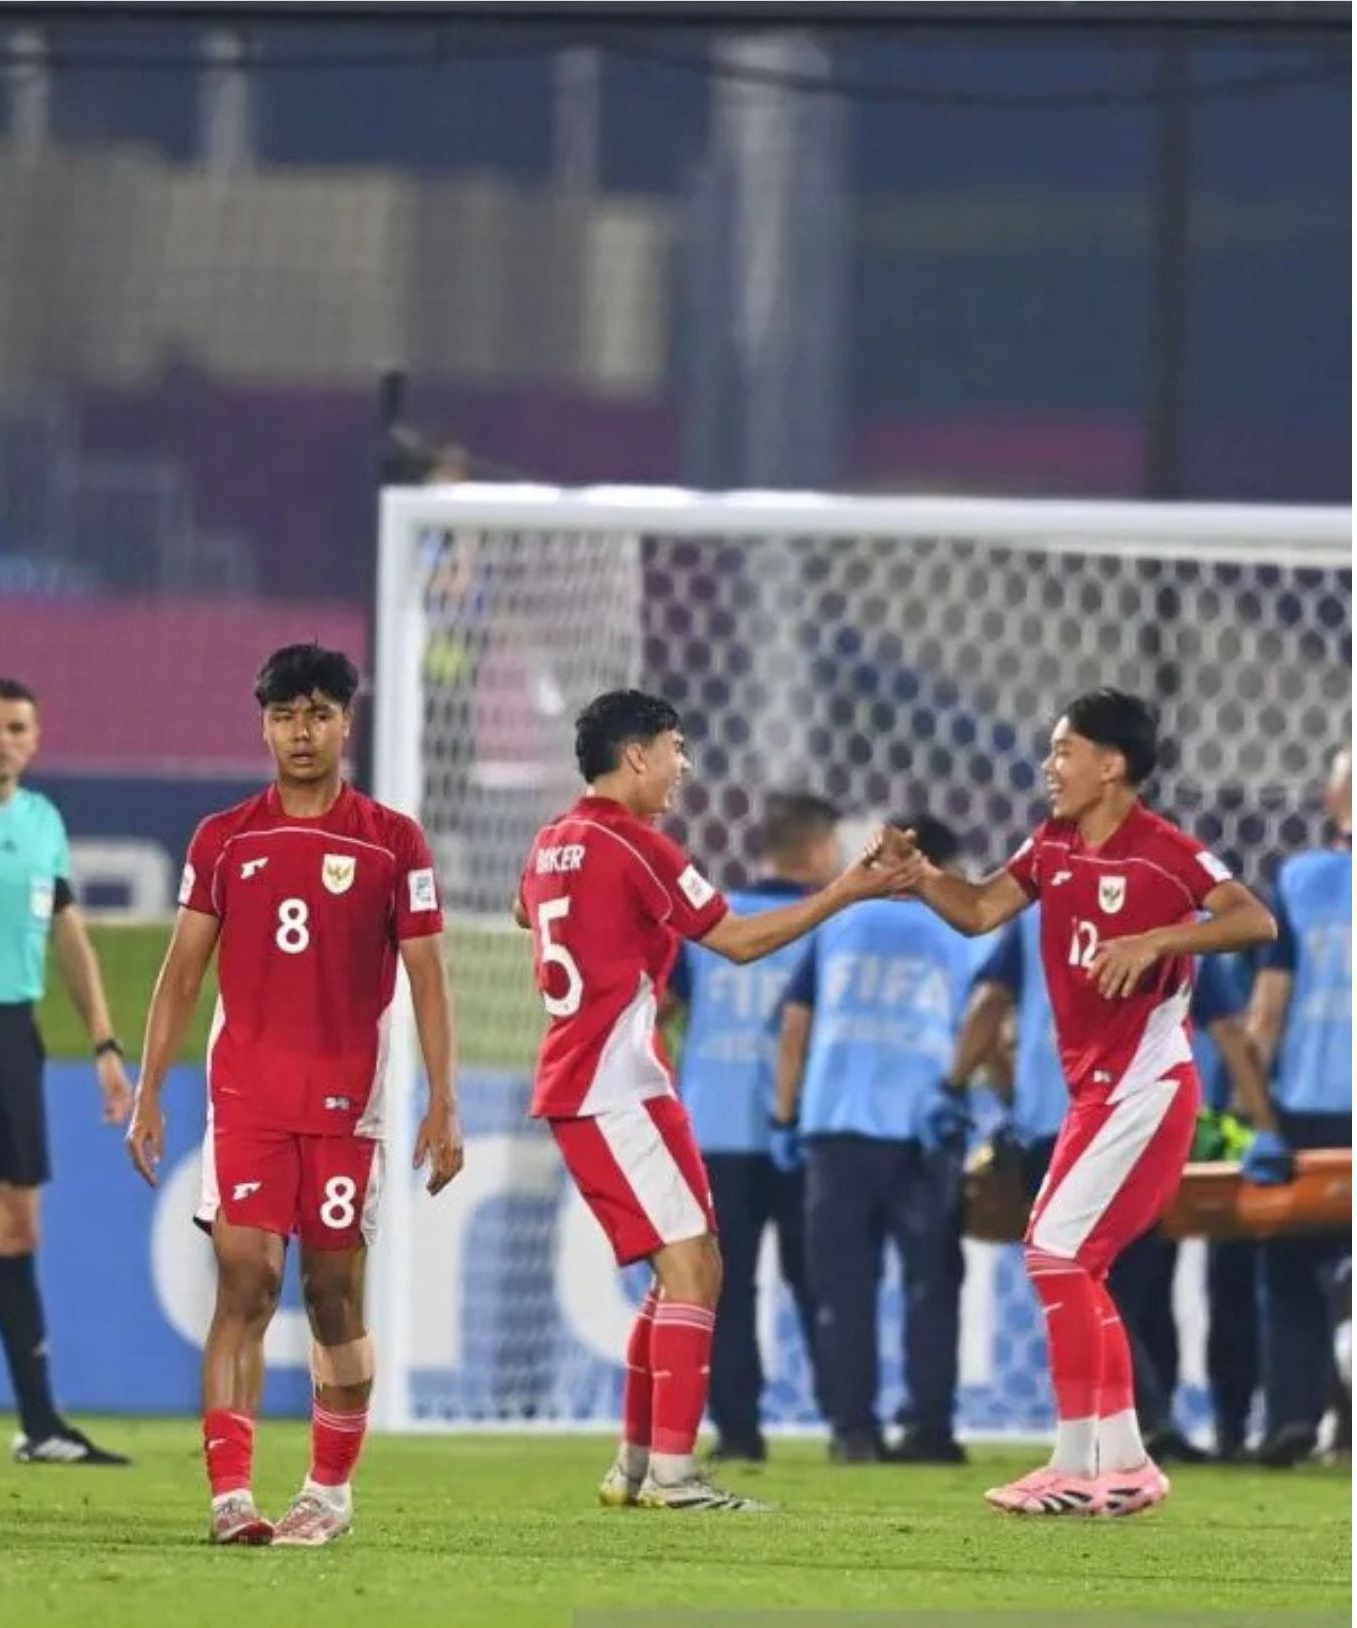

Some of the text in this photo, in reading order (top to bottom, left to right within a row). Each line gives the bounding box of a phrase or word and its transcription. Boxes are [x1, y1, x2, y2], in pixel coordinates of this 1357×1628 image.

[276, 898, 310, 954] 8
[538, 897, 584, 1017] 5
[320, 1176, 357, 1229] 8
